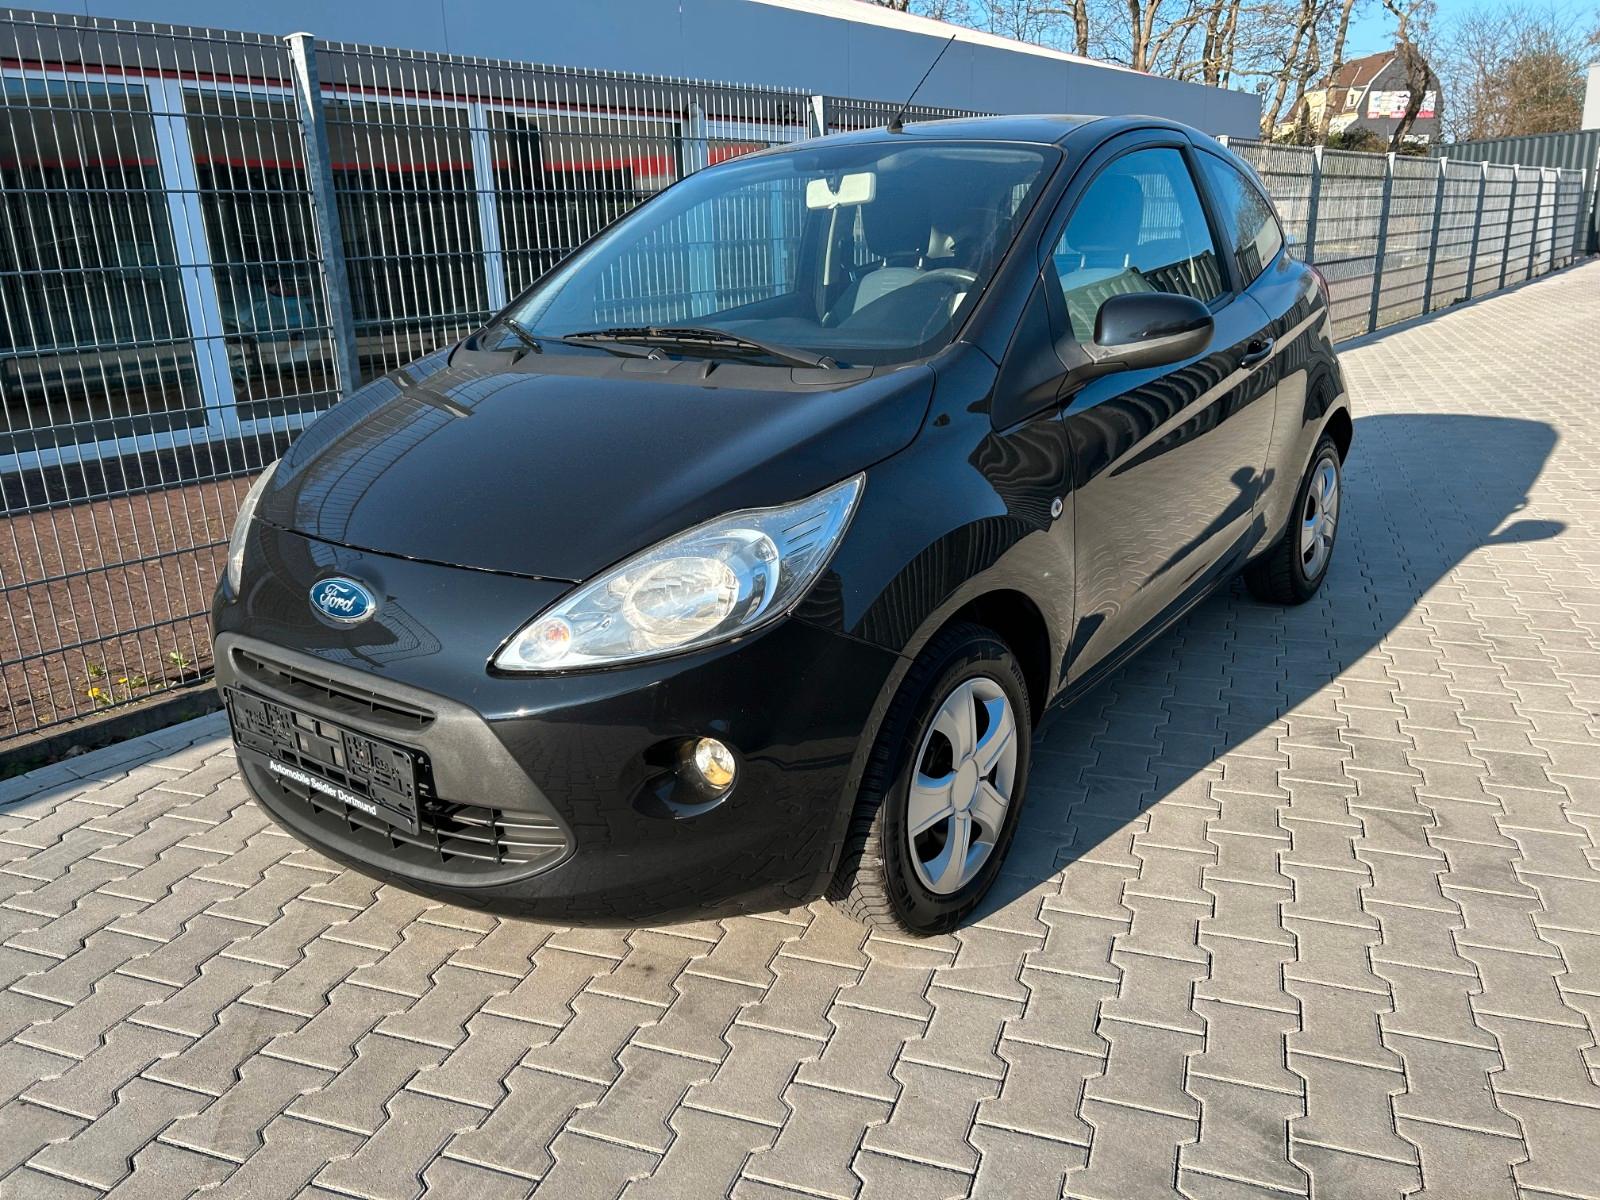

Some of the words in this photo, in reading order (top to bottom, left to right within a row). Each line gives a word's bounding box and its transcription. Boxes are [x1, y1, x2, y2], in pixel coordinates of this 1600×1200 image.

[320, 583, 357, 612] Ford
[270, 760, 311, 785] Automobile
[338, 789, 377, 815] Dortmund
[890, 822, 915, 913] NEXEN
